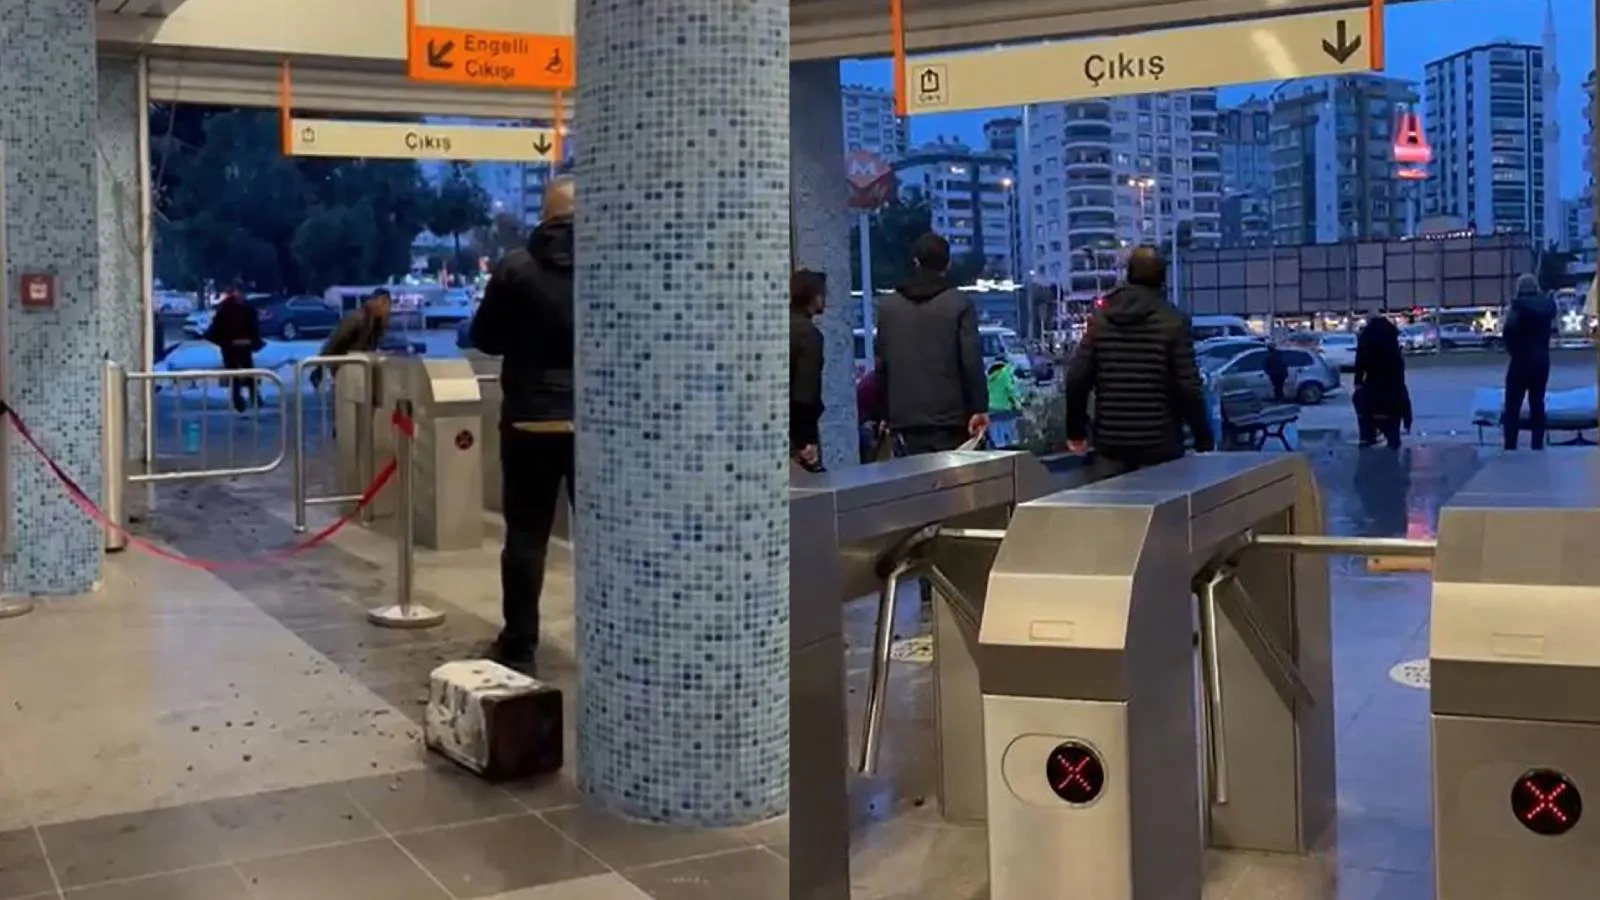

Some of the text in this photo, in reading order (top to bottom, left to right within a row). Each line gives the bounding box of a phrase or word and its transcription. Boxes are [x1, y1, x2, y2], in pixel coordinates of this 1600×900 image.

[464, 34, 528, 55] Engelli
[465, 60, 515, 81] Çıkışı
[1084, 52, 1164, 87] Çıkış
[405, 132, 451, 151] Çıkış
